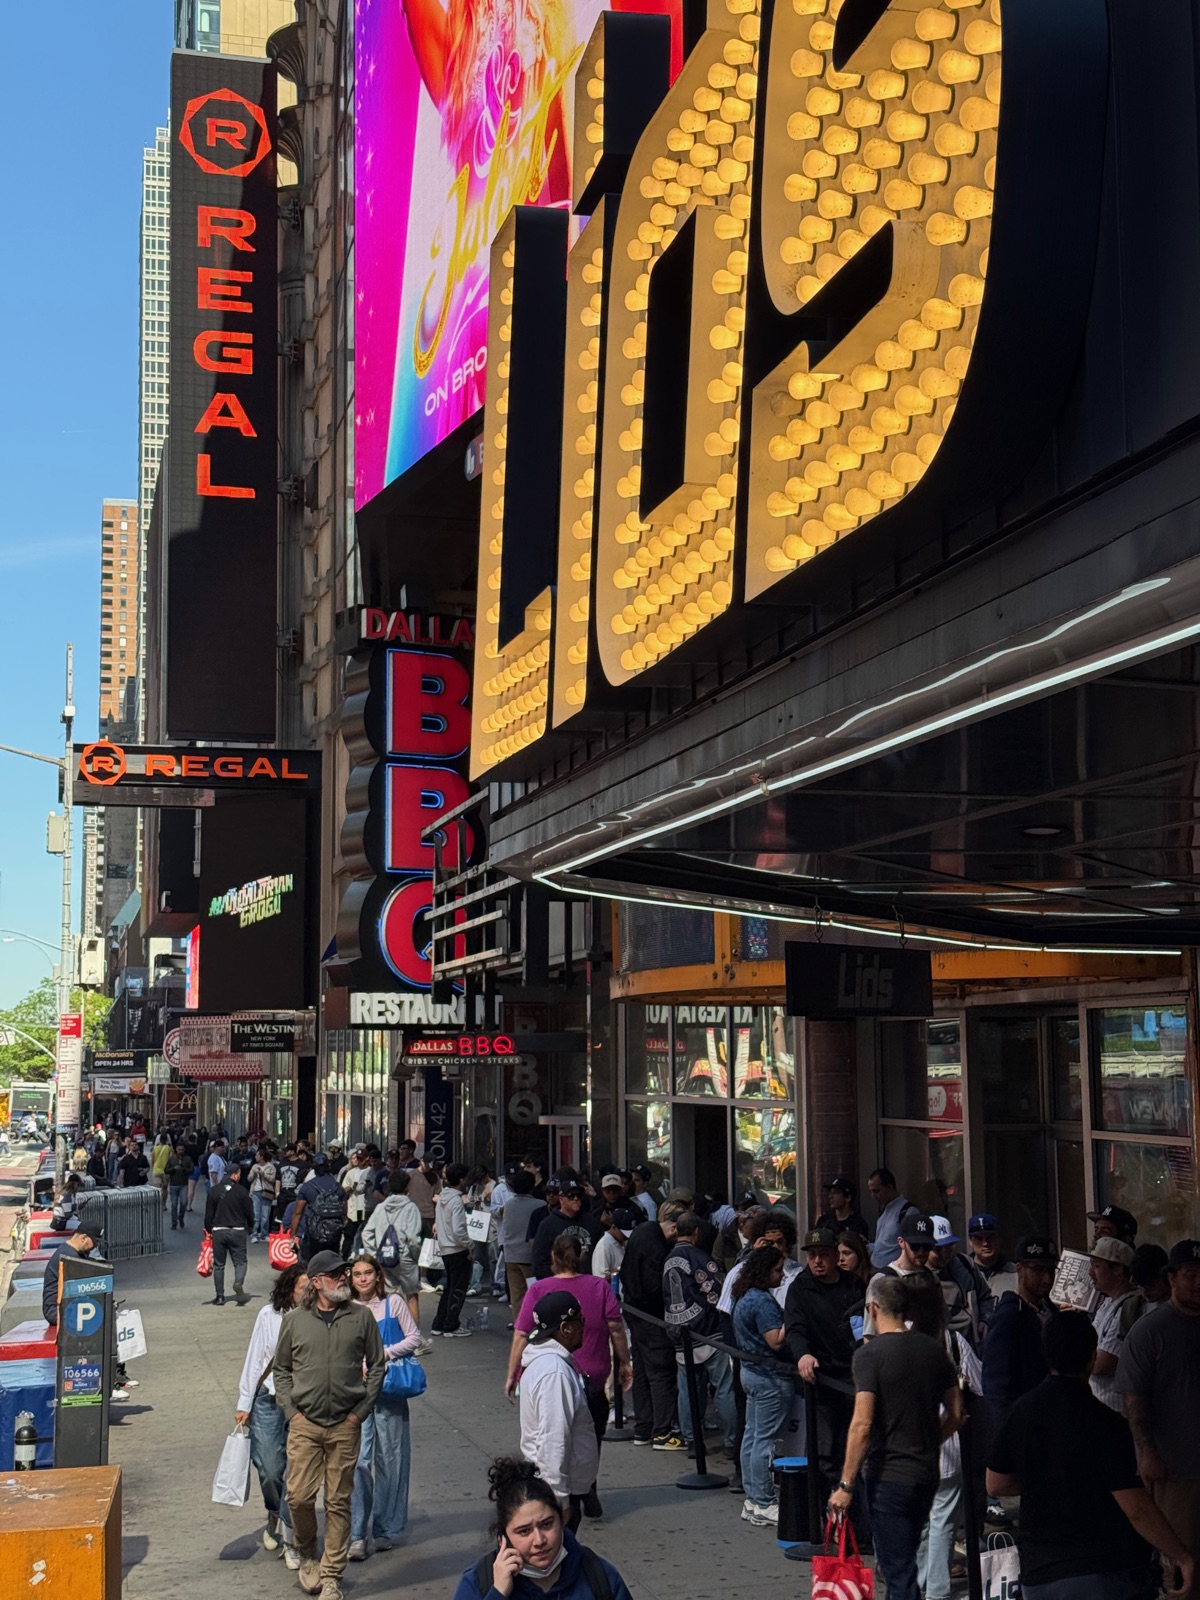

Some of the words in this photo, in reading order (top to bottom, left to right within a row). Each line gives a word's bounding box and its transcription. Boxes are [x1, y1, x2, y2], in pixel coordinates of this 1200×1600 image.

[193, 204, 258, 499] REGAL
[424, 379, 448, 417] ON
[452, 345, 488, 395] BRO
[361, 607, 477, 650] DALLA
[145, 753, 309, 779] REGAL
[377, 648, 476, 993] BBQ
[838, 952, 893, 1008] Lids
[232, 1023, 253, 1034] THE
[253, 1023, 295, 1034] WESTIN
[413, 1042, 453, 1051] DALLAS
[458, 1035, 514, 1056] BBQ
[430, 1102, 446, 1125] 42
[77, 1281, 107, 1293] 106566
[76, 1302, 96, 1332] P
[118, 1327, 135, 1342] ds
[64, 1368, 100, 1379] 106566
